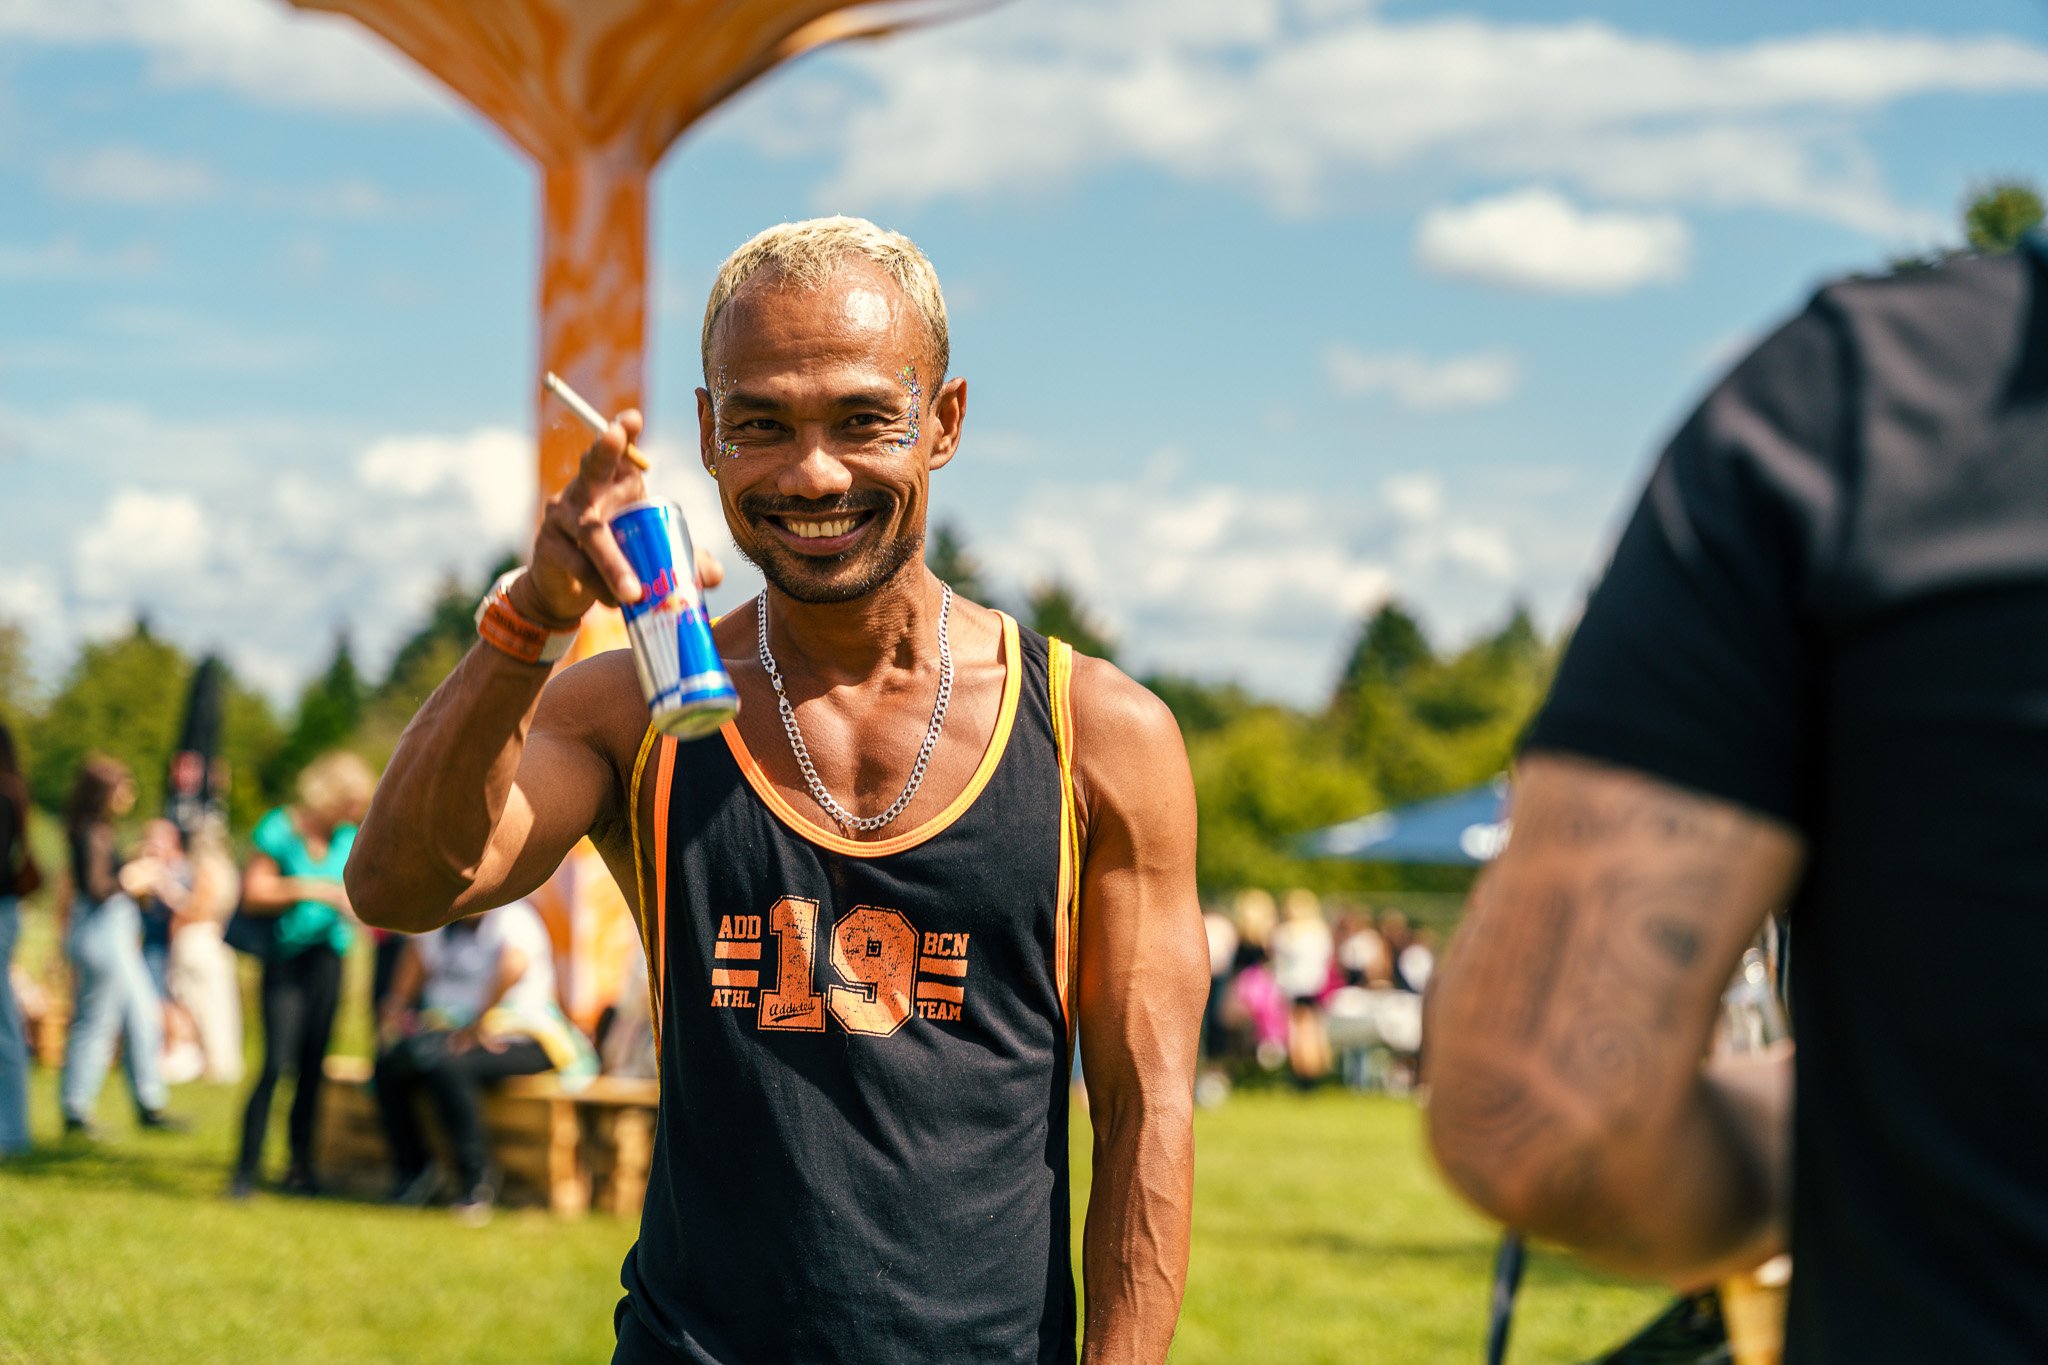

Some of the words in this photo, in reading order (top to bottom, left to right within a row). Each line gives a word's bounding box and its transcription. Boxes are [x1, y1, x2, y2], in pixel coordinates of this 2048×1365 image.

[718, 915, 761, 939] ADD
[923, 932, 970, 957] BCN
[758, 895, 919, 1037] 19
[711, 989, 756, 1008] ATHL.
[916, 1001, 962, 1022] TEAM
